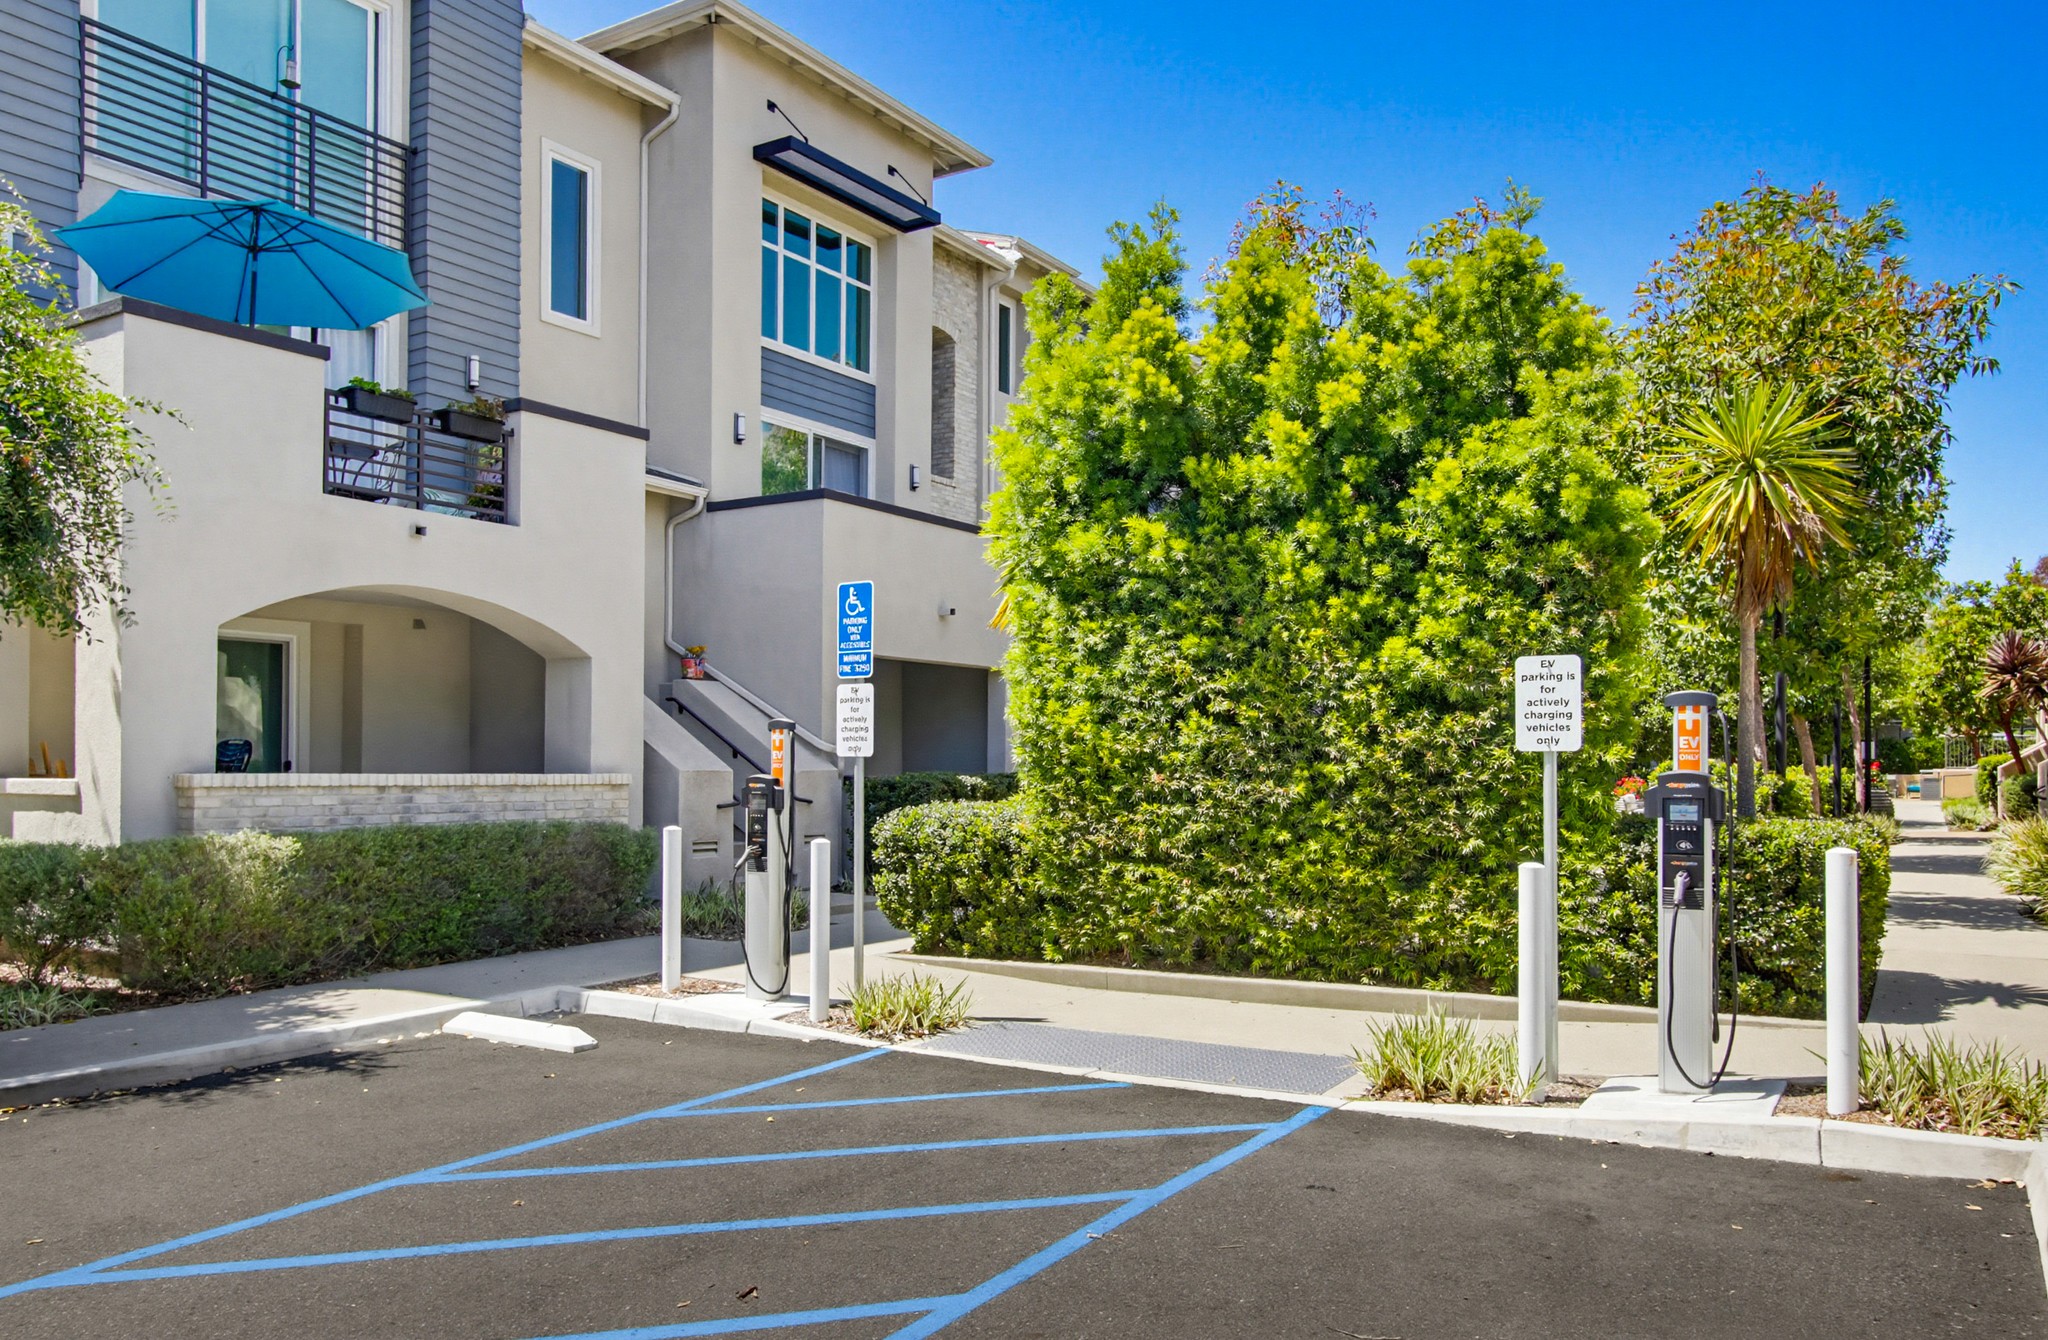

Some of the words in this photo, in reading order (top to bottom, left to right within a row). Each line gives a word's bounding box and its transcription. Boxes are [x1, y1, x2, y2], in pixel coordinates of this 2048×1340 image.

[843, 617, 867, 625] PARKING
[847, 625, 862, 633] ONLY
[843, 654, 867, 662] MINIMUM
[1540, 660, 1555, 668] EV
[840, 665, 851, 673] FINE
[1521, 672, 1563, 682] parking
[1567, 672, 1575, 680] is
[1540, 685, 1556, 693] for
[840, 696, 864, 704] parking
[1526, 698, 1570, 707] actively
[1524, 711, 1573, 720] charging
[841, 726, 869, 734] charging
[1526, 723, 1571, 732] vehicles
[1536, 736, 1560, 746] only
[1679, 736, 1699, 748] EV
[772, 751, 783, 759] EV
[1679, 753, 1700, 761] ONLY
